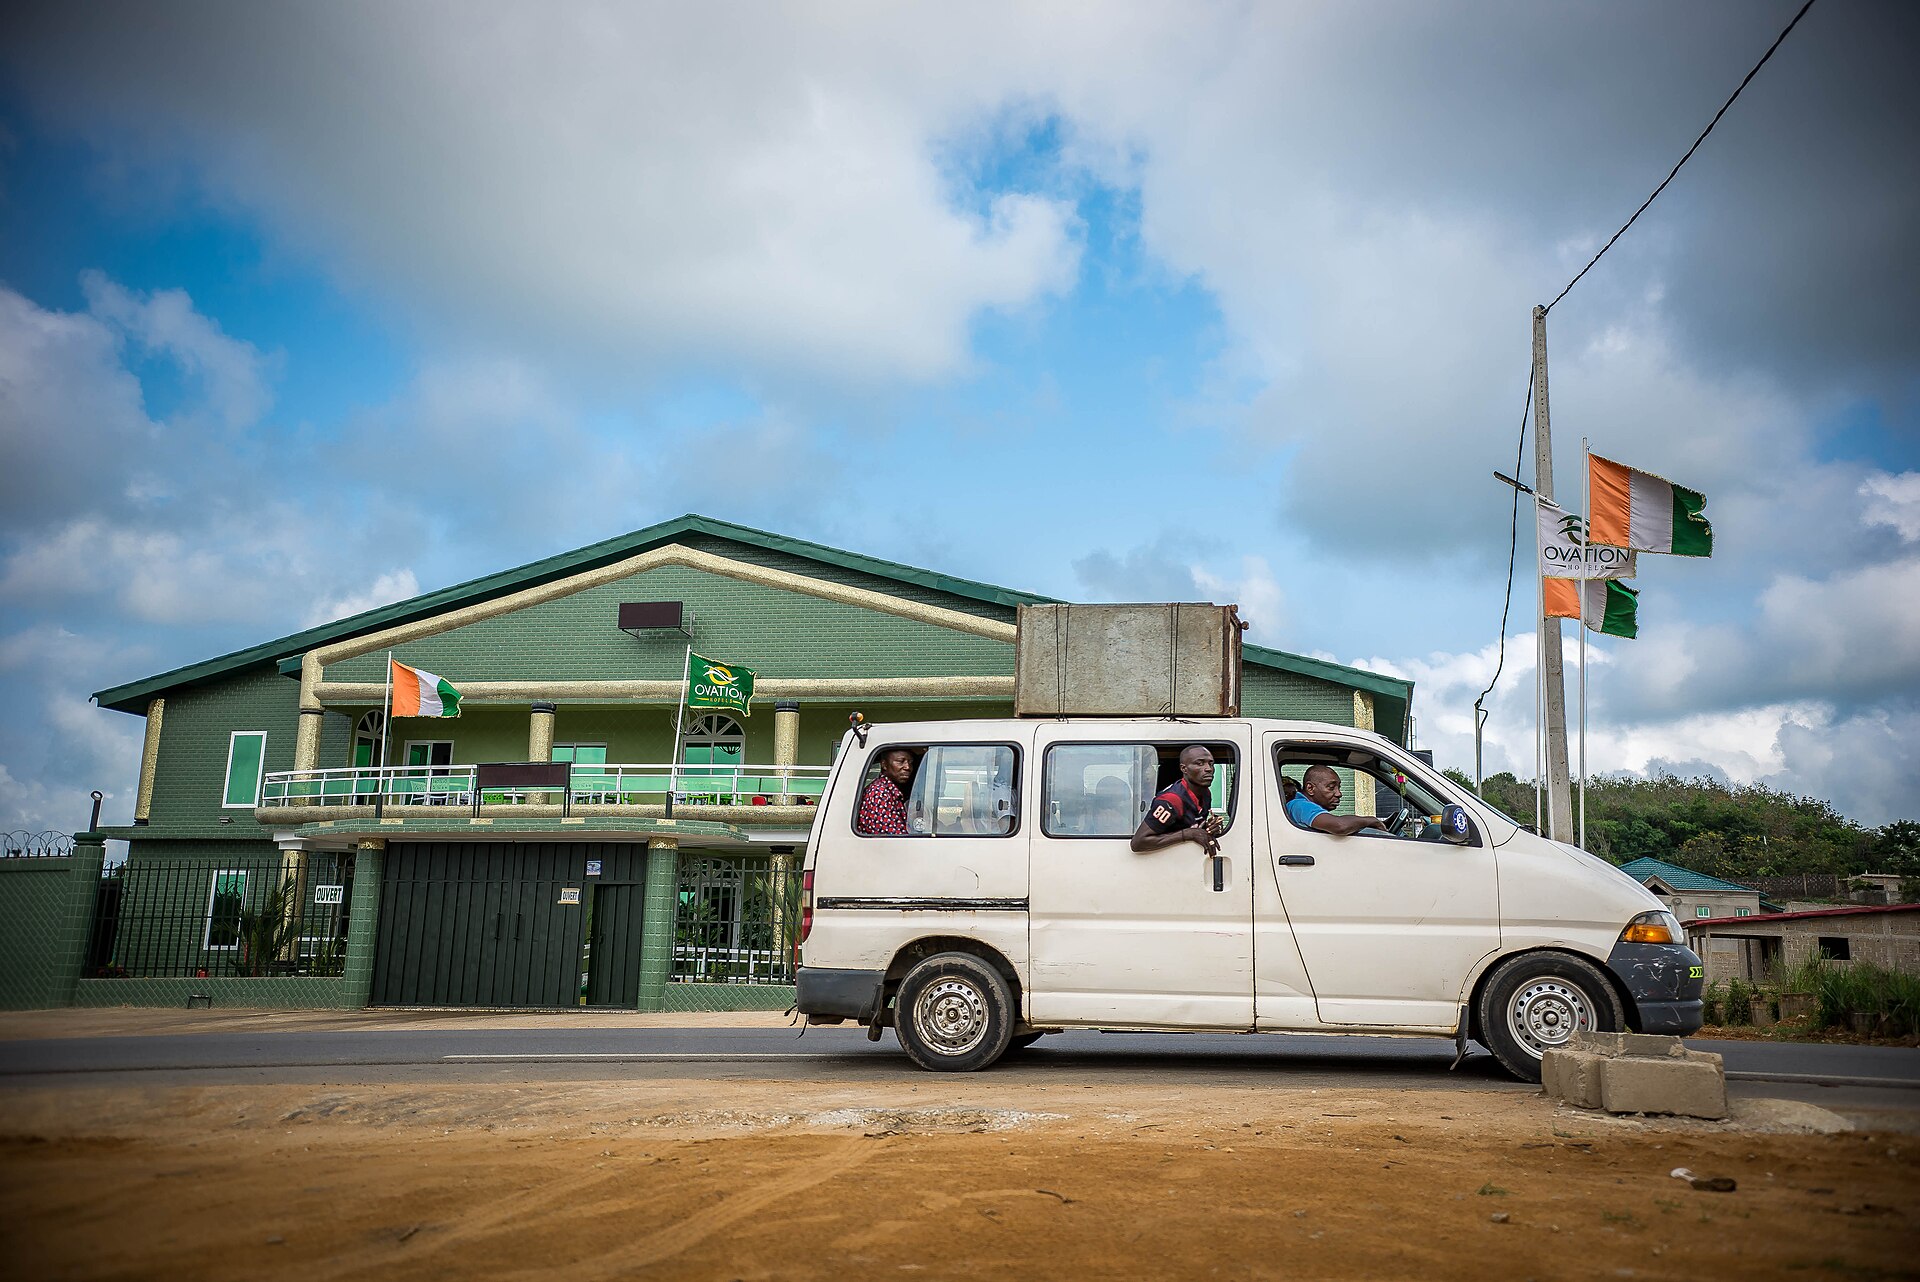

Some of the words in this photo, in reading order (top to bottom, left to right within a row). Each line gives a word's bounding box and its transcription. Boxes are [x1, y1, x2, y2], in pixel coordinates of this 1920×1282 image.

[1544, 546, 1630, 563] OVATION
[694, 684, 747, 704] OVATION
[1152, 804, 1172, 824] 80
[316, 887, 342, 902] OUVERT
